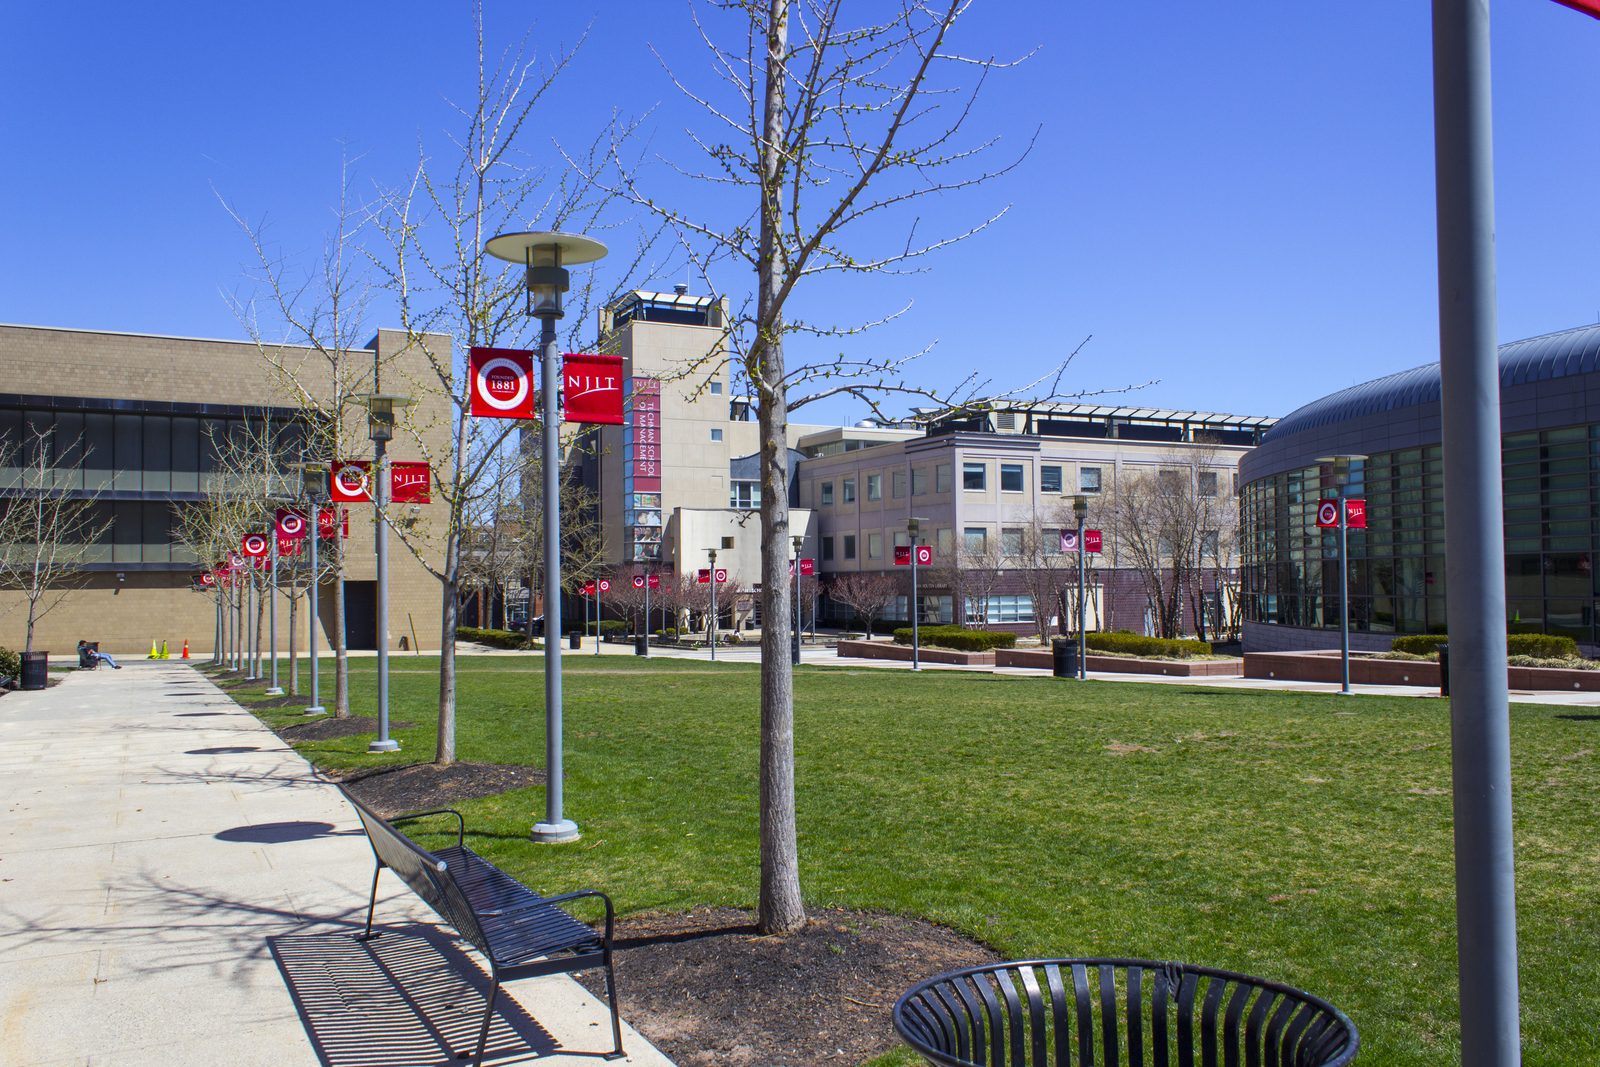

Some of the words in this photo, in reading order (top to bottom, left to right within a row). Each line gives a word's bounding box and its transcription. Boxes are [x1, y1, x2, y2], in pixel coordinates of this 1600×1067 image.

[491, 380, 515, 390] 1881
[568, 375, 615, 391] NJIT
[639, 415, 647, 472] MANAGEMENT
[647, 445, 655, 477] SCHOOL
[394, 474, 425, 483] NJIT
